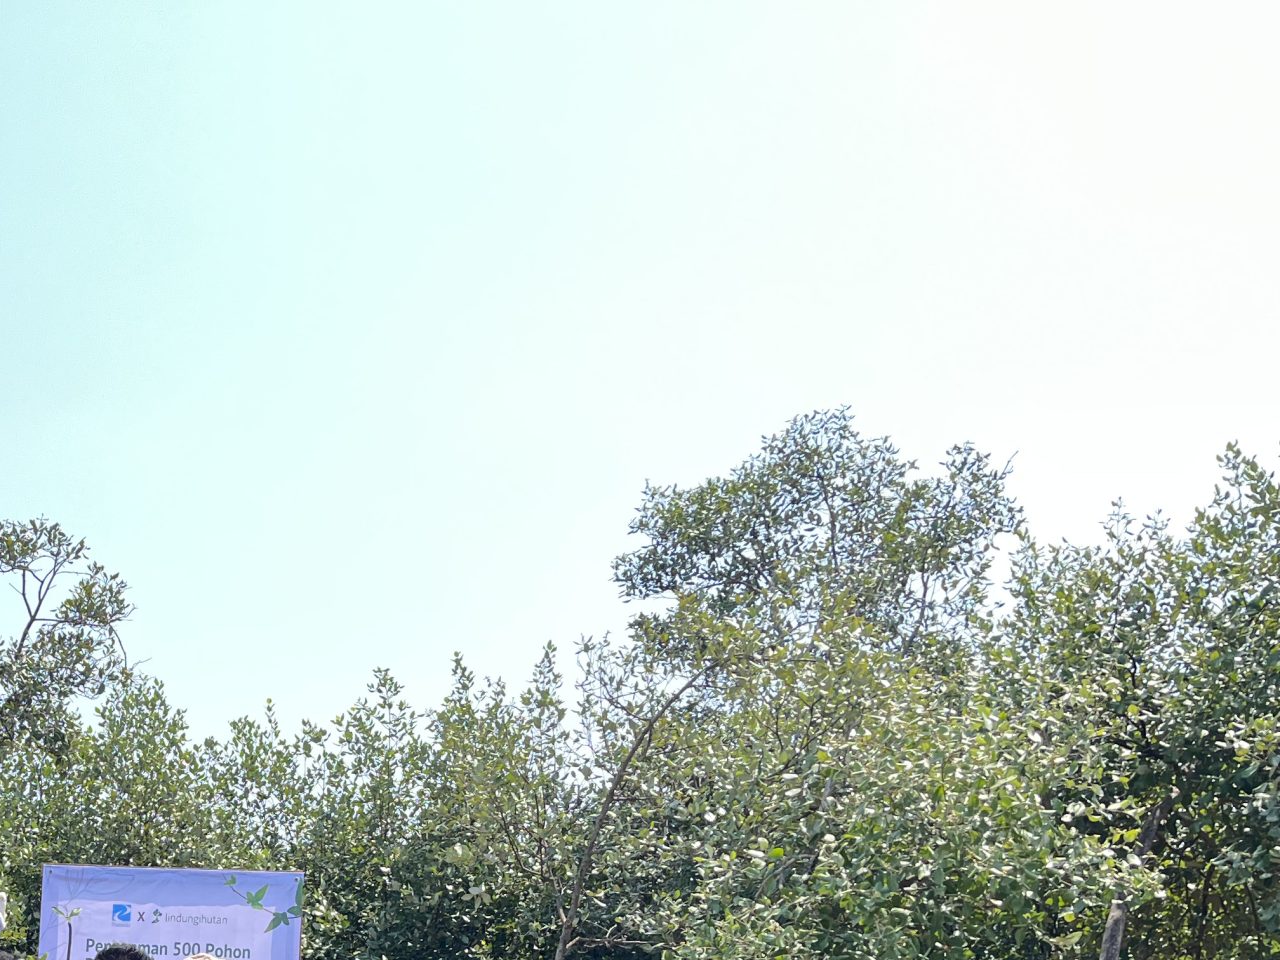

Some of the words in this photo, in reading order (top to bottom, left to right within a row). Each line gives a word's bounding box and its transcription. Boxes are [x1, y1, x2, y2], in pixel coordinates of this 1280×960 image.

[165, 913, 228, 926] lindungihutan
[173, 942, 201, 956] 500
[205, 943, 251, 959] Pohon
